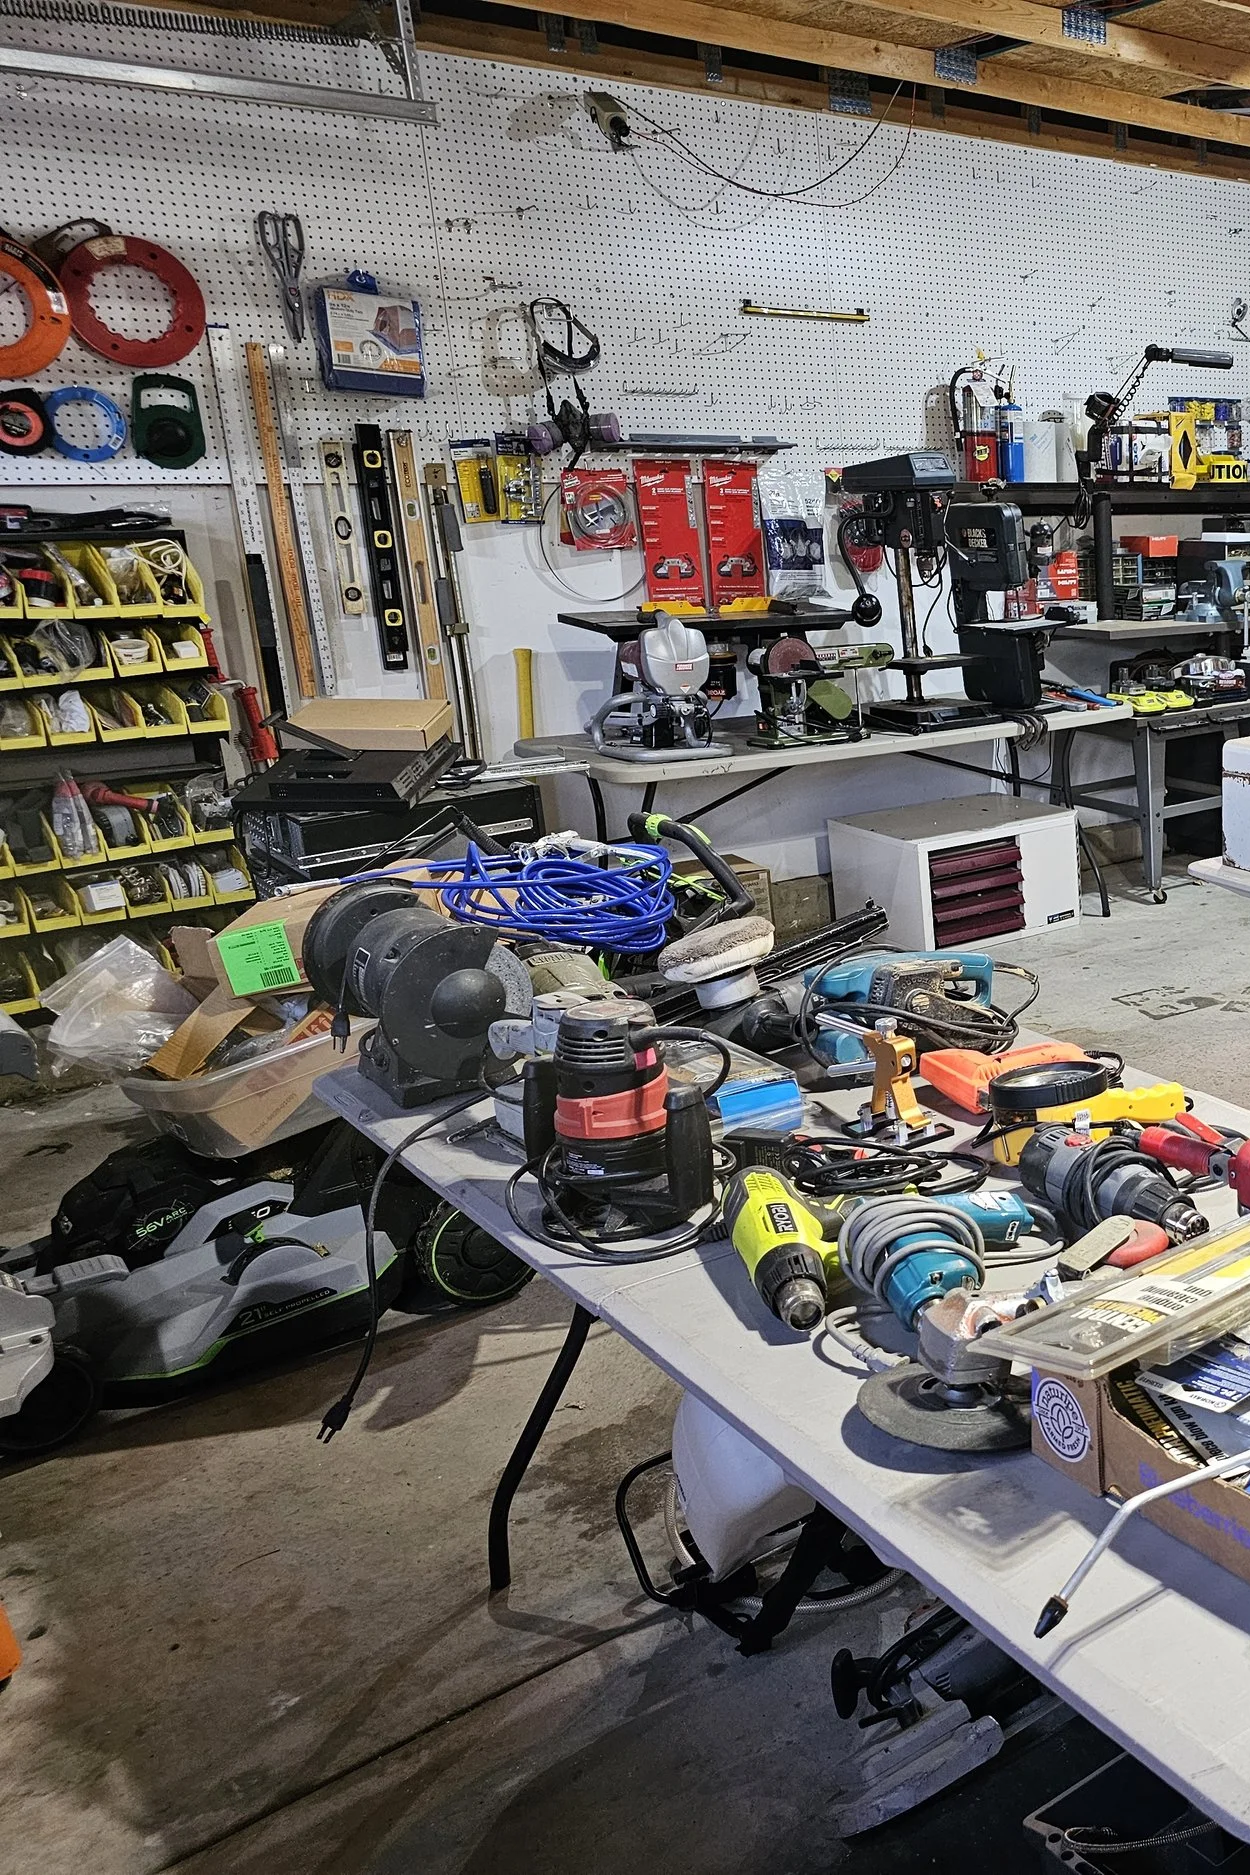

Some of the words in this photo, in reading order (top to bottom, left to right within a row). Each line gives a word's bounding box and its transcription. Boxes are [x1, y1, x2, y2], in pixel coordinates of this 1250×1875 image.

[327, 290, 354, 301] HDX
[968, 538, 988, 548] DECKER
[135, 1217, 165, 1238] 56V
[165, 1207, 187, 1221] ARC
[770, 1204, 795, 1232] RYOBI
[1140, 1285, 1199, 1304] cleaning
[1184, 1285, 1213, 1298] gun
[1086, 1300, 1168, 1325] PNEUMATIC
[1136, 1294, 1185, 1312] engine
[1070, 1308, 1153, 1333] CENTRAL
[1042, 1386, 1078, 1421] naturipe
[1116, 1379, 1176, 1440] PNEUMATIC
[1189, 1394, 1215, 1405] KOBALT
[1170, 1404, 1193, 1425] gun
[1183, 1420, 1209, 1442] blow
